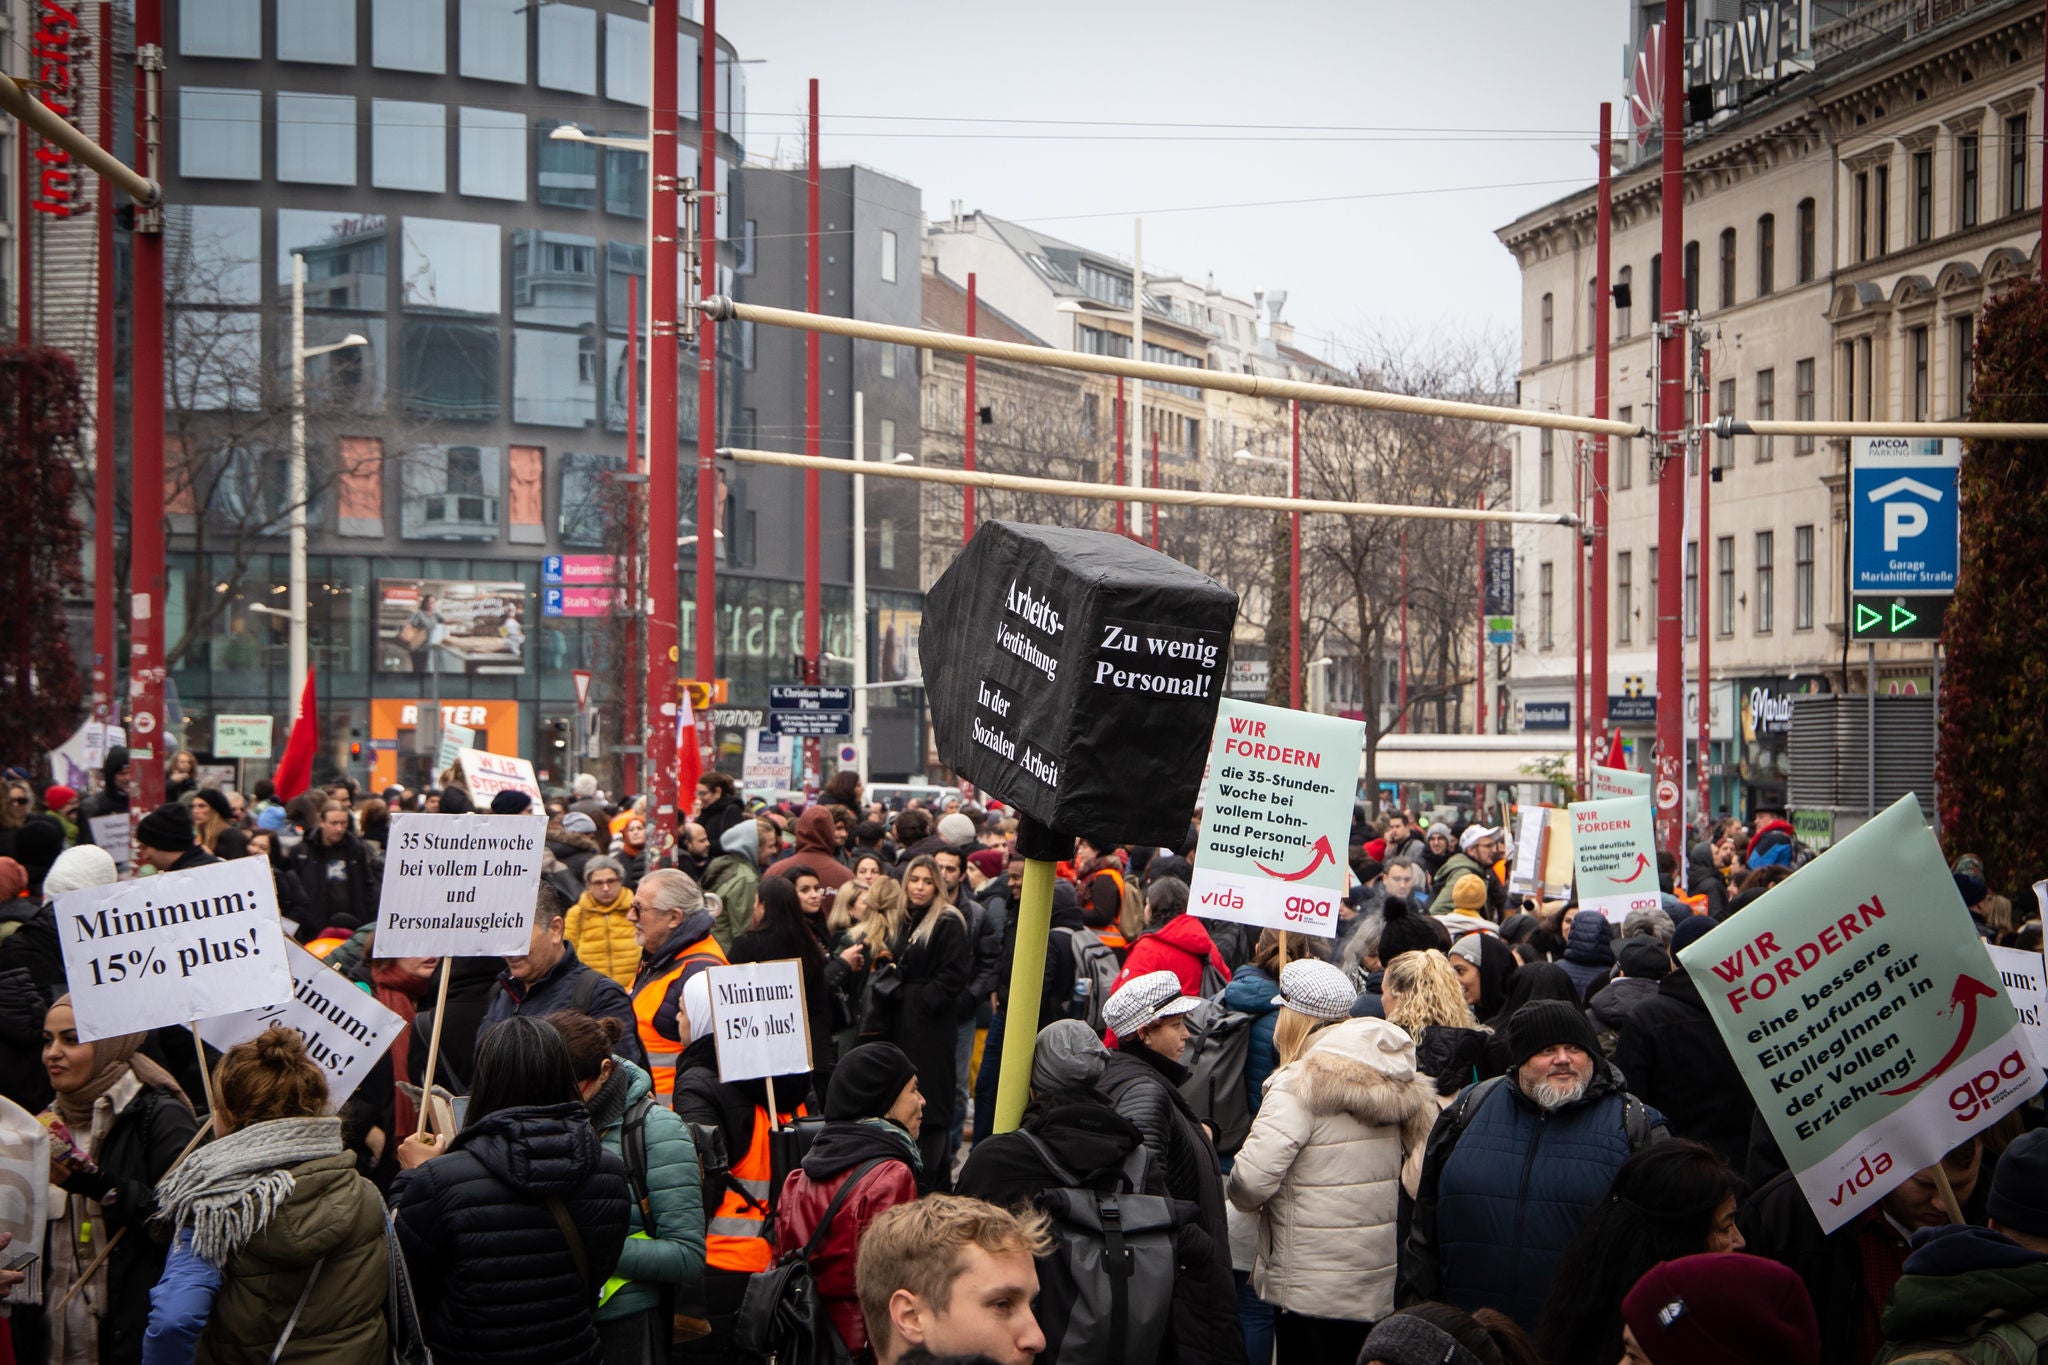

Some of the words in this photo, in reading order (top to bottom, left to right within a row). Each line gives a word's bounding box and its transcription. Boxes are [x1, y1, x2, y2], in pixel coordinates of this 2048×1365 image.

[32, 0, 77, 216] Intrcity
[1869, 439, 1909, 448] APCOA
[1884, 502, 1928, 552] P
[1861, 571, 1917, 582] Mariahilfer
[1920, 571, 1953, 582] Straße
[1889, 559, 1925, 571] Garage
[1004, 578, 1064, 635] Arbeits-
[1101, 625, 1138, 652] Zu
[1146, 638, 1219, 668] wenig
[1093, 661, 1212, 698] Personal!
[977, 680, 991, 707] In
[991, 689, 1011, 717] der
[1636, 708, 1655, 716] Bank
[1229, 717, 1267, 738] WIR
[972, 717, 1015, 761] Sozialen
[1020, 746, 1060, 788] Arbeit
[1225, 738, 1321, 768] FORDERN
[480, 756, 519, 777] WIR
[1597, 775, 1611, 783] WIR
[1221, 766, 1244, 780] die
[1247, 770, 1335, 794] 35-Stunden-
[1596, 783, 1633, 796] FORDERN
[1219, 784, 1267, 803] Woche
[1271, 792, 1293, 807] bei
[1215, 805, 1263, 821] vollem
[1267, 811, 1308, 827] Lohn-
[1576, 810, 1598, 822] WIR
[1577, 820, 1631, 834] FORDERN
[400, 833, 420, 850] 35
[423, 833, 534, 850] Stundenwoche
[1213, 823, 1240, 836] und
[1244, 826, 1312, 847] Personal-
[1579, 844, 1597, 852] eine
[1599, 840, 1636, 850] deutliche
[1210, 842, 1284, 862] ausgleich!
[1580, 853, 1620, 863] Erhöhung
[400, 860, 423, 876] bei
[428, 860, 477, 876] vollem
[481, 860, 528, 877] Lohn-
[1581, 863, 1620, 873] Gehälter!
[446, 886, 477, 903] und
[1201, 888, 1244, 910] vida
[72, 890, 258, 943] Minimum:
[1284, 896, 1331, 922] gpa
[387, 912, 524, 933] Personalausgleich
[87, 946, 166, 987] 15%
[177, 927, 261, 978] plus!
[1711, 931, 1783, 984] WIR
[1726, 894, 1887, 1015] FORDERN
[1746, 1007, 1800, 1044] eine
[1801, 942, 1891, 1012] bessere
[1756, 980, 1883, 1070] Einstufung
[1884, 953, 1919, 984] für
[725, 1015, 759, 1041] 15%
[1770, 992, 1907, 1094] KollegInnen
[1909, 976, 1934, 999] in
[1785, 1082, 1824, 1117] der
[1826, 1031, 1901, 1086] Vollen
[1948, 1049, 2026, 1122] gpa
[1794, 1047, 1918, 1141] Erziehung!
[1827, 1152, 1894, 1207] vida
